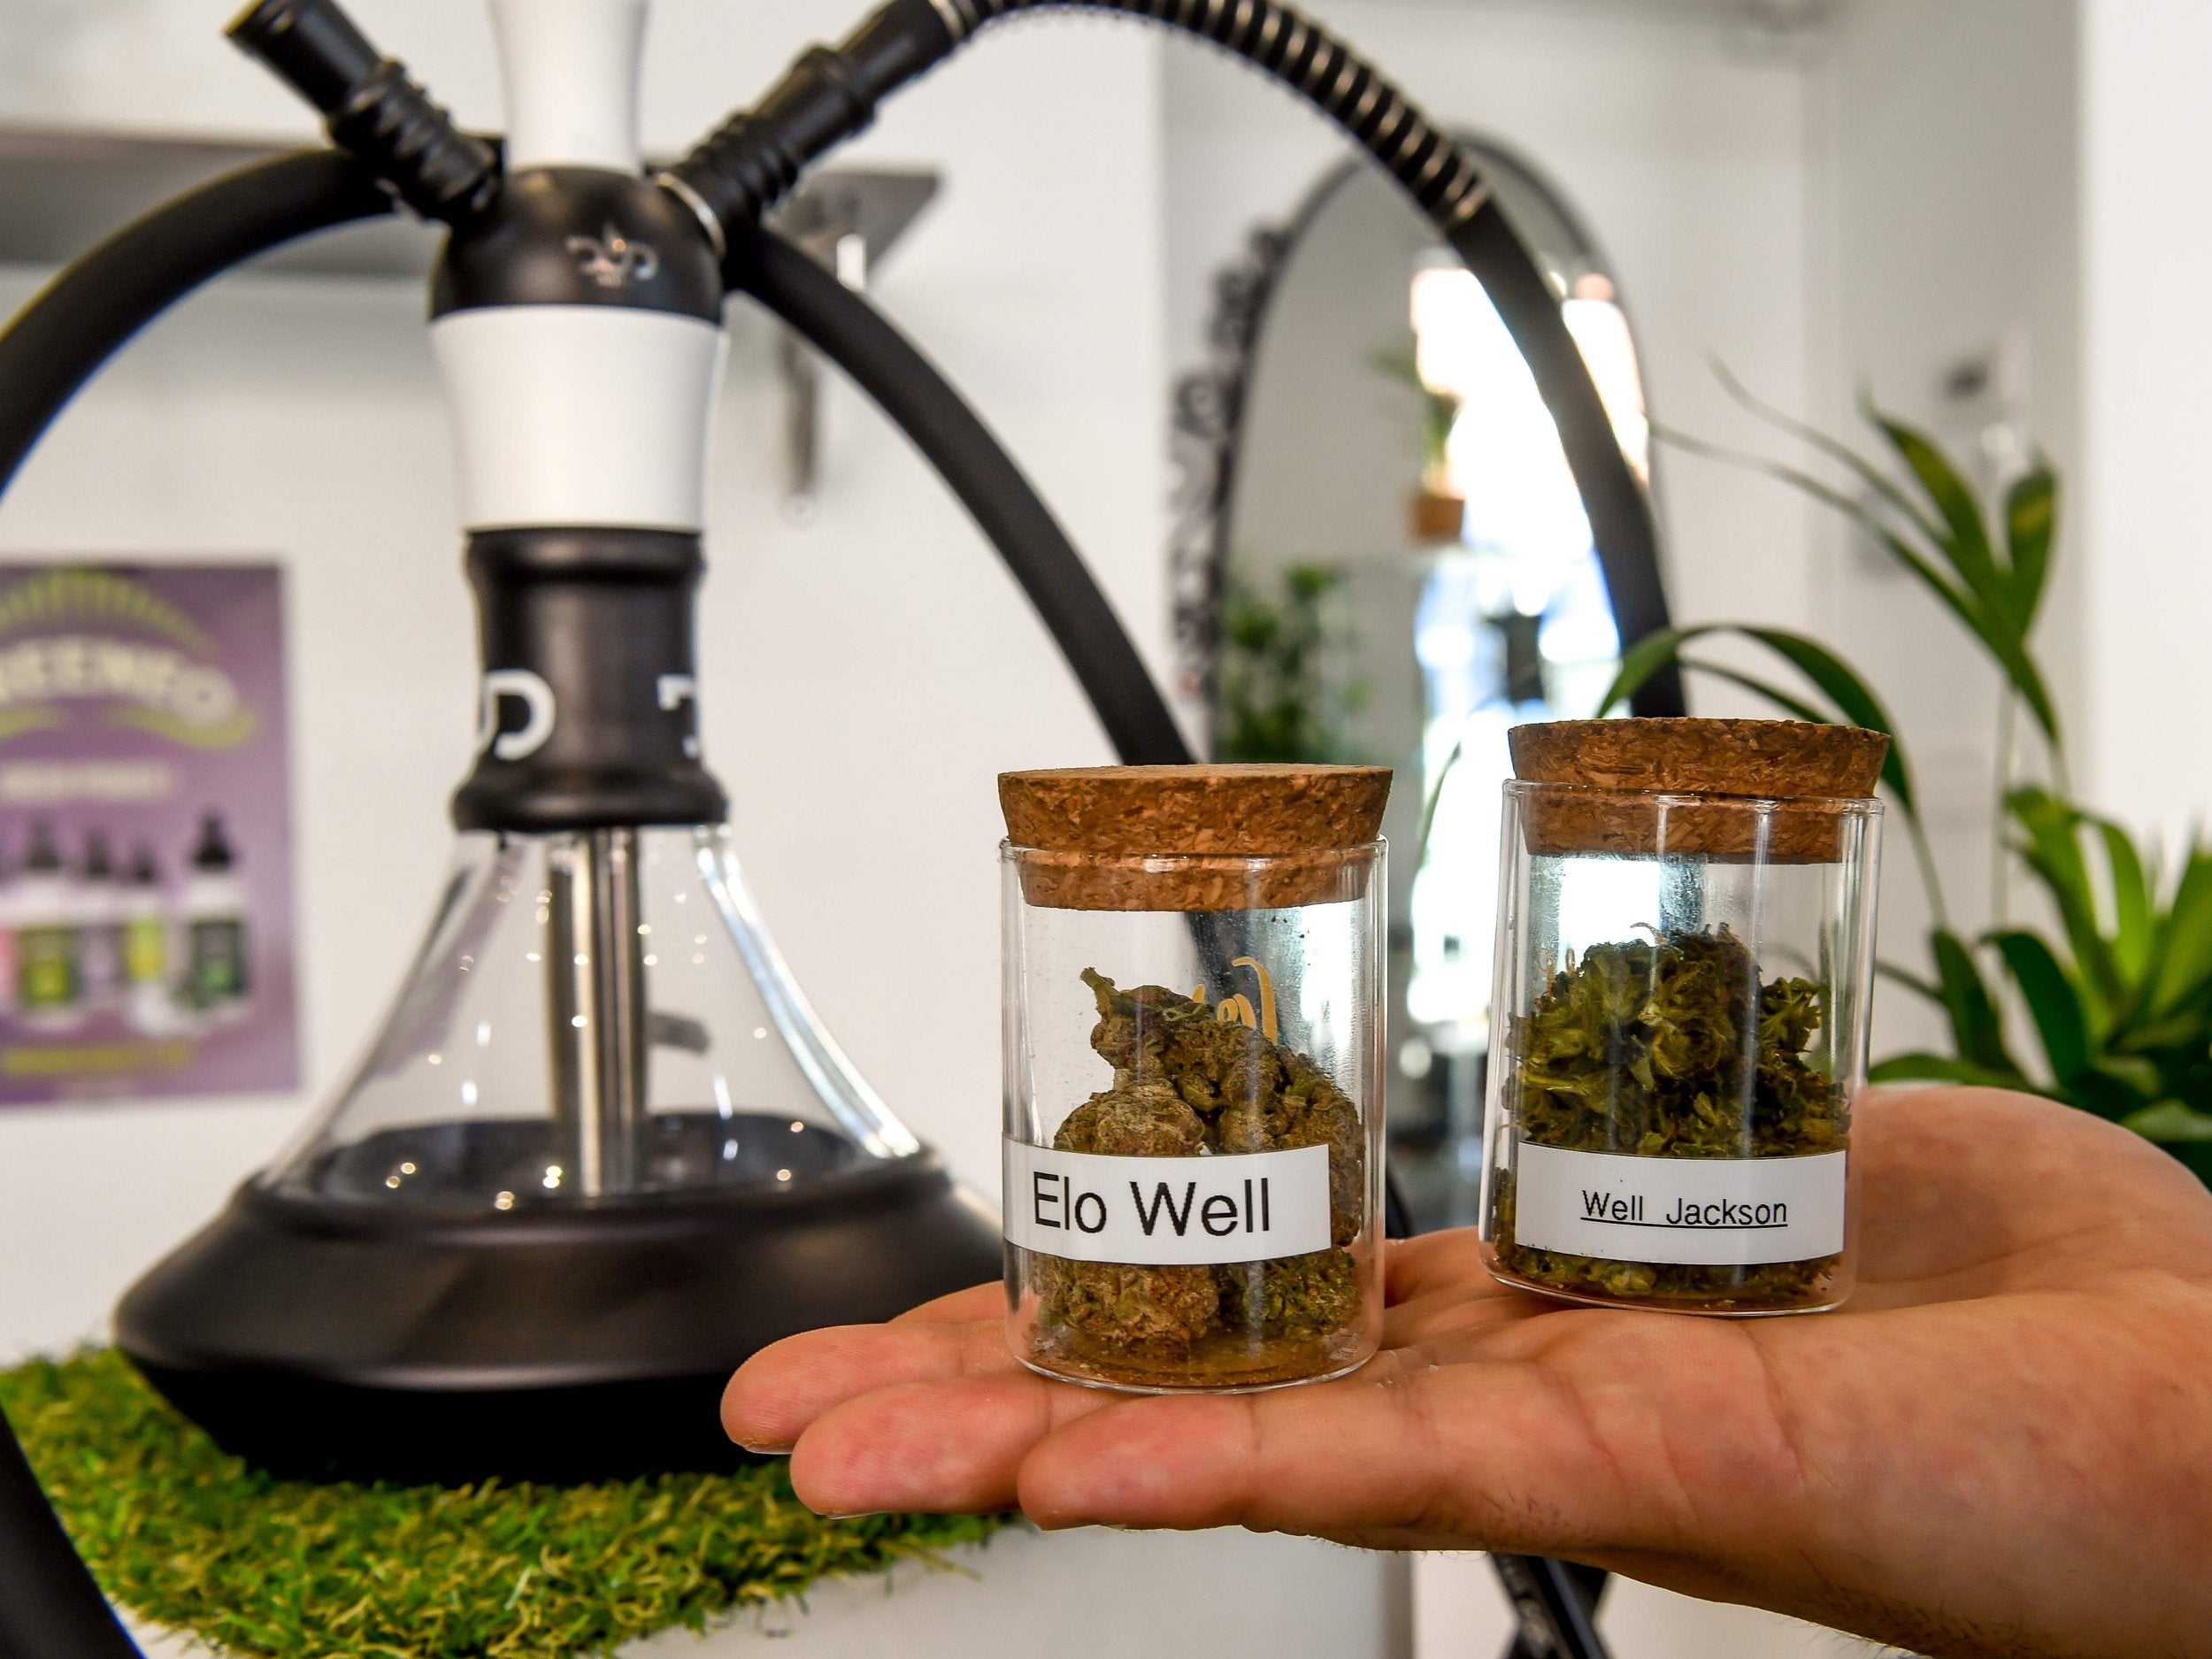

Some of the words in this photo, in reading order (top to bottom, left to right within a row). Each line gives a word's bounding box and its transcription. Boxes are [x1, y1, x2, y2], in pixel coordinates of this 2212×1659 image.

[1033, 1171, 1108, 1234] Elo
[1129, 1177, 1270, 1237] Well
[1581, 1189, 1644, 1221] Well
[1666, 1197, 1787, 1226] Jackson
